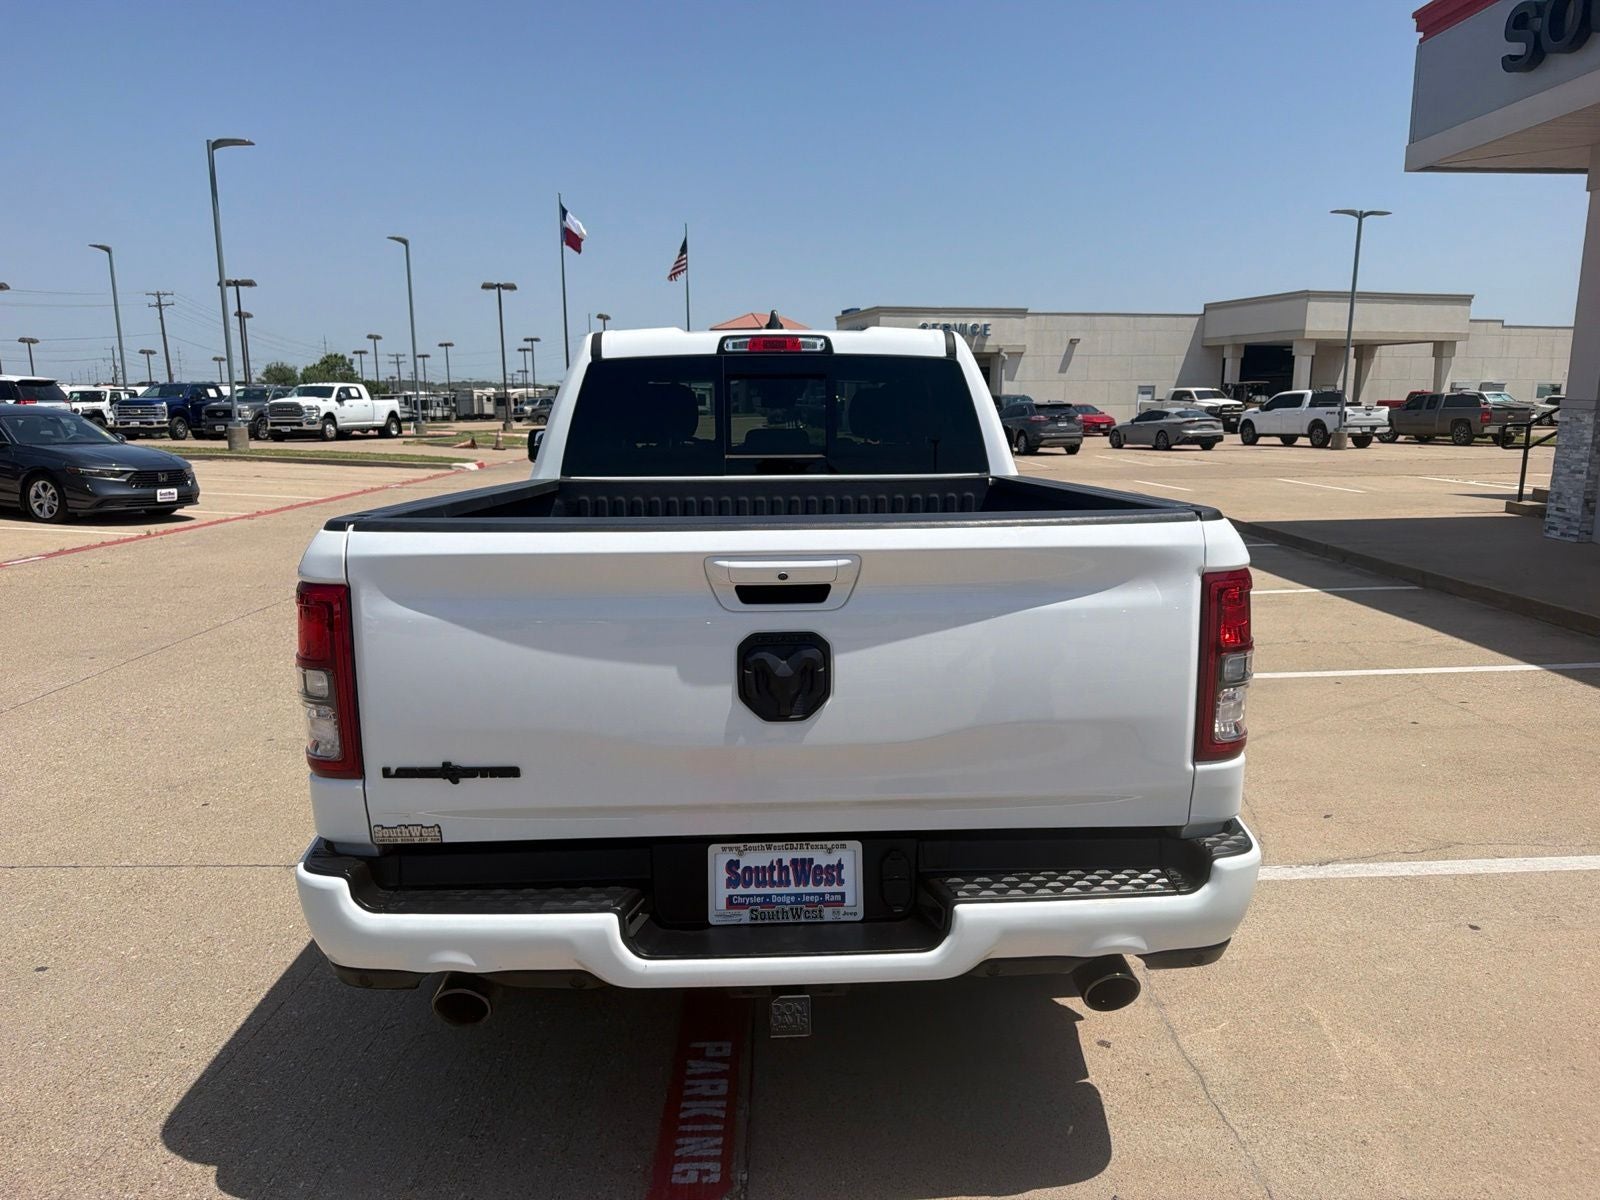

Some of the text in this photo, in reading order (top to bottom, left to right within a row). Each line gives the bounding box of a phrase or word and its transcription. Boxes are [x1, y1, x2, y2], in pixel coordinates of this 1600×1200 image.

[1502, 0, 1600, 73] SO
[374, 825, 441, 837] SouthWest
[725, 857, 845, 889] SouthWest
[732, 893, 842, 905] Chrysler Dodge Jeep Ram
[750, 906, 824, 921] SouthWest
[671, 1041, 732, 1184] PARKING
